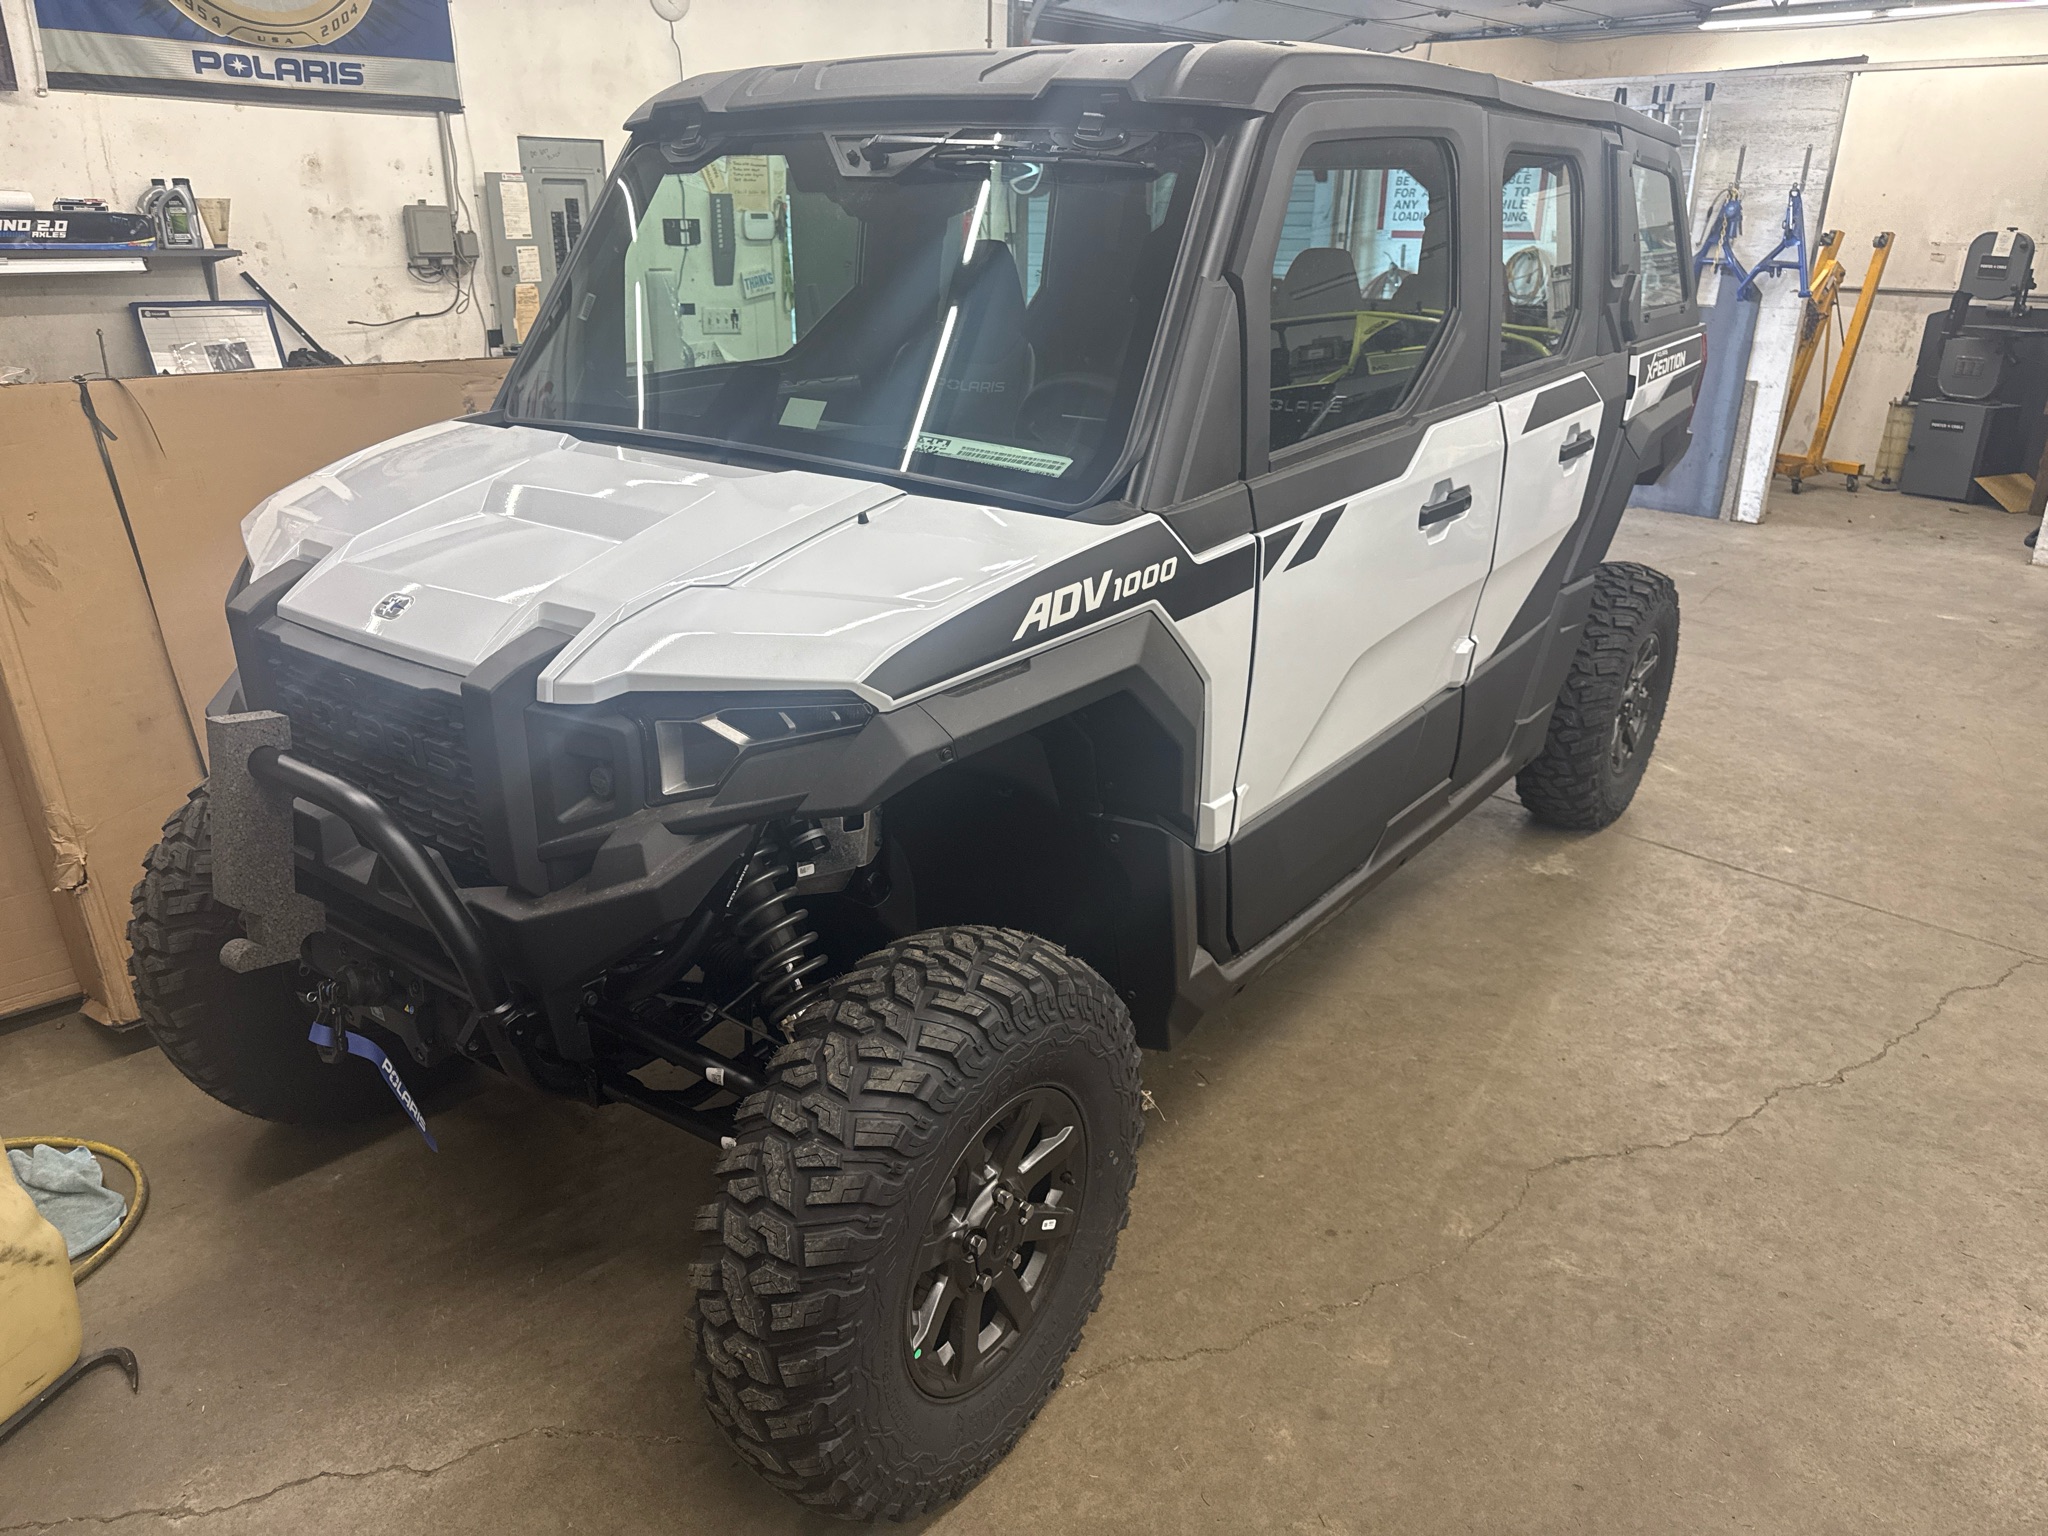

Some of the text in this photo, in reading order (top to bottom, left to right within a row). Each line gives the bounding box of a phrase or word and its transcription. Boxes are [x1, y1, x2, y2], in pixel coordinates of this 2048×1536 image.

[176, 0, 222, 28] 954
[320, 3, 358, 38] 2004
[257, 35, 294, 45] USA
[191, 50, 364, 86] POLARIS
[1396, 176, 1410, 186] BE
[1394, 188, 1416, 198] FOR
[1514, 186, 1531, 197] TO
[1393, 200, 1419, 210] ANY
[36, 219, 68, 232] 2.0
[31, 231, 67, 239] AXLES
[744, 272, 774, 291] THANKS
[1646, 351, 1686, 384] XPEDITION
[1012, 556, 1178, 642] ADV 1000
[381, 1057, 427, 1132] POLARIS
